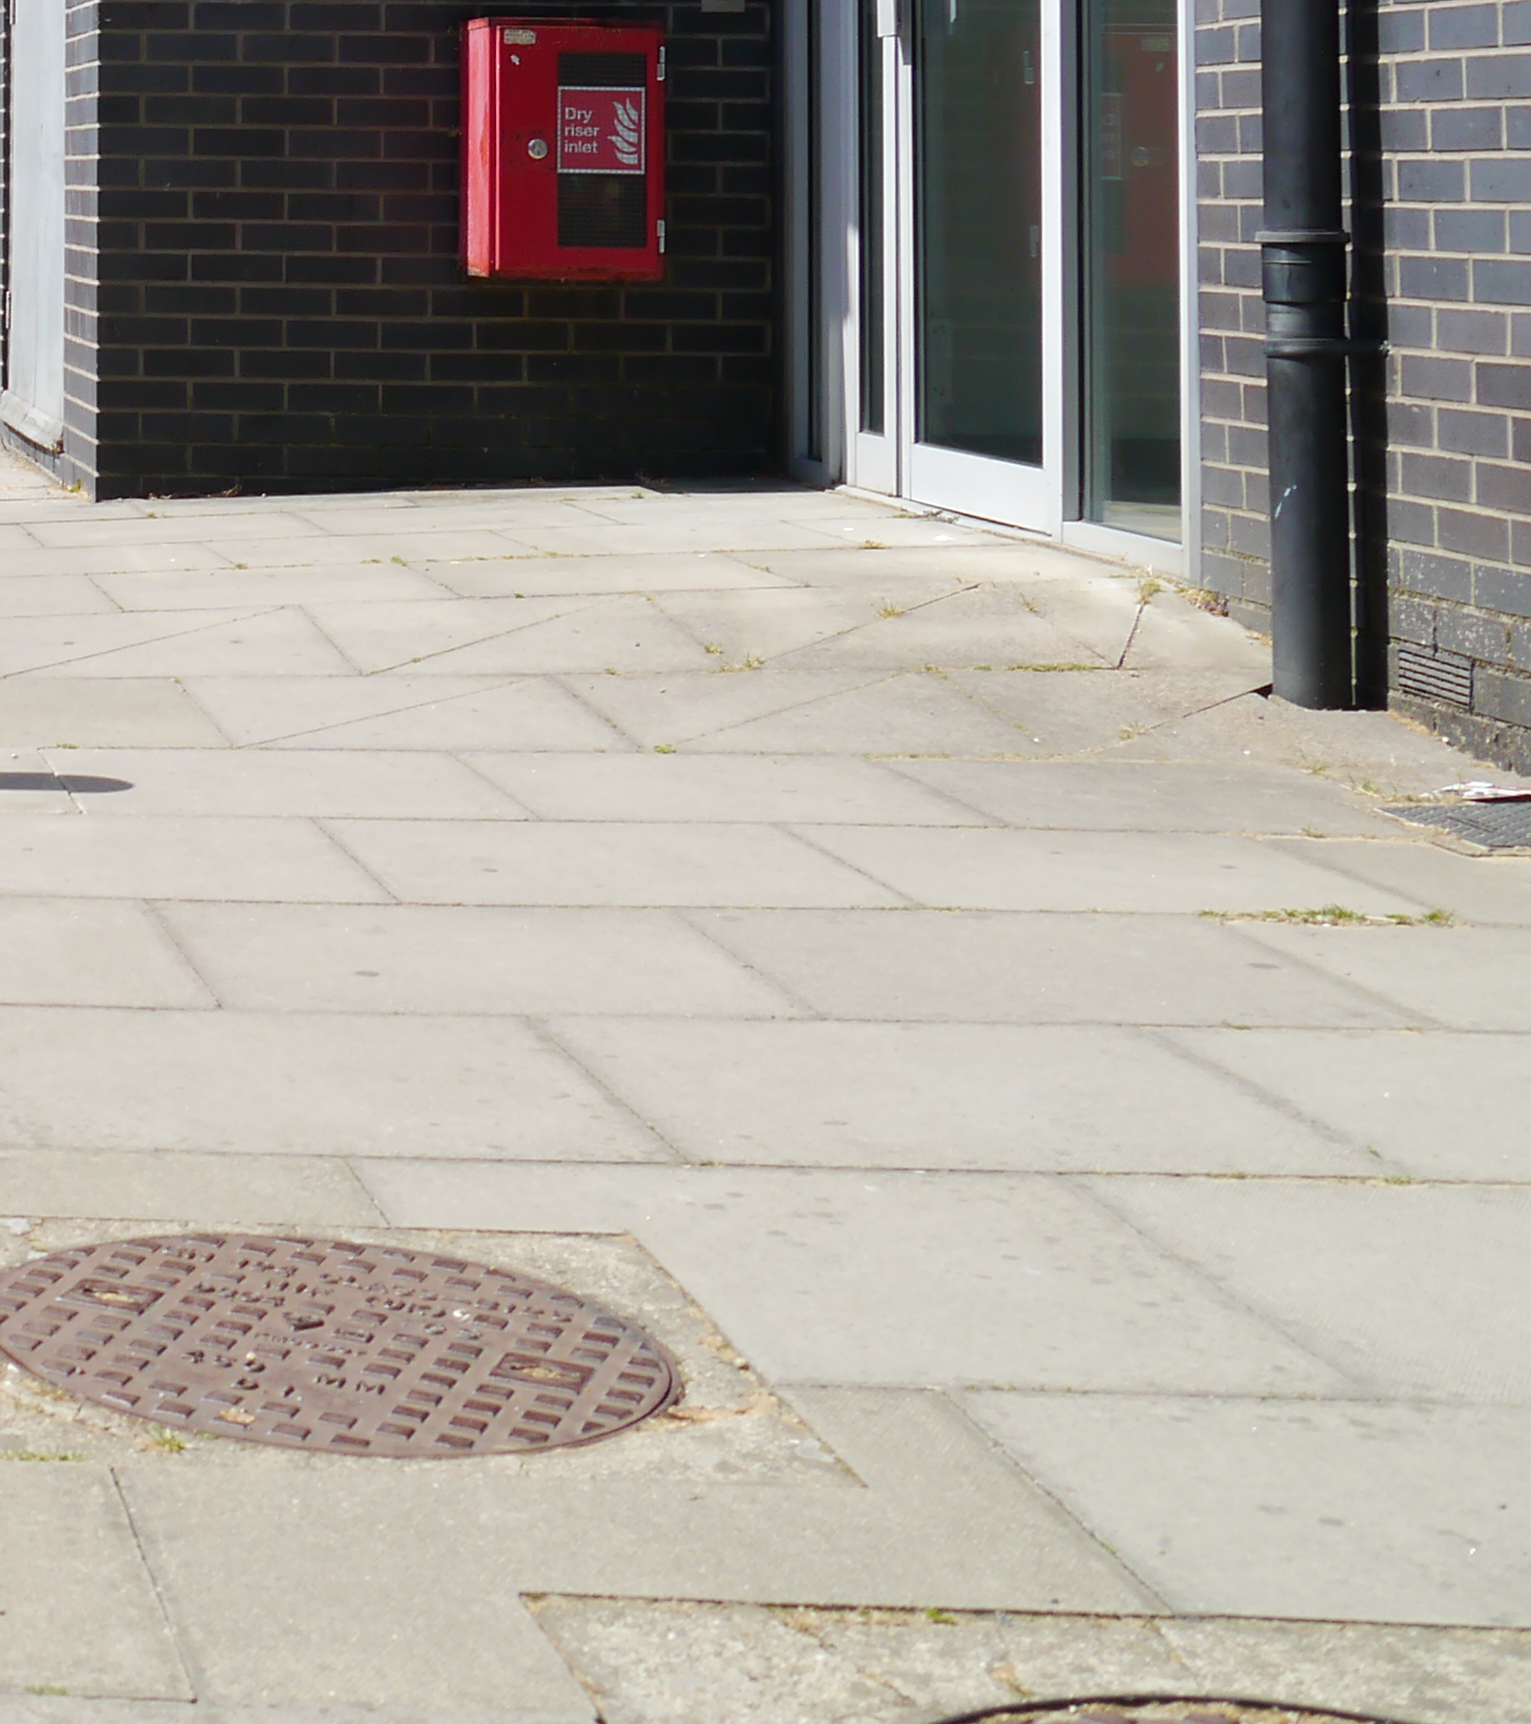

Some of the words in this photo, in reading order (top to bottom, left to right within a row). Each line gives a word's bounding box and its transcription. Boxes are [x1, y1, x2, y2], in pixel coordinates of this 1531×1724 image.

[564, 107, 593, 124] Dry
[564, 124, 600, 138] riser
[564, 140, 599, 154] inlet
[313, 1374, 387, 1395] MM
